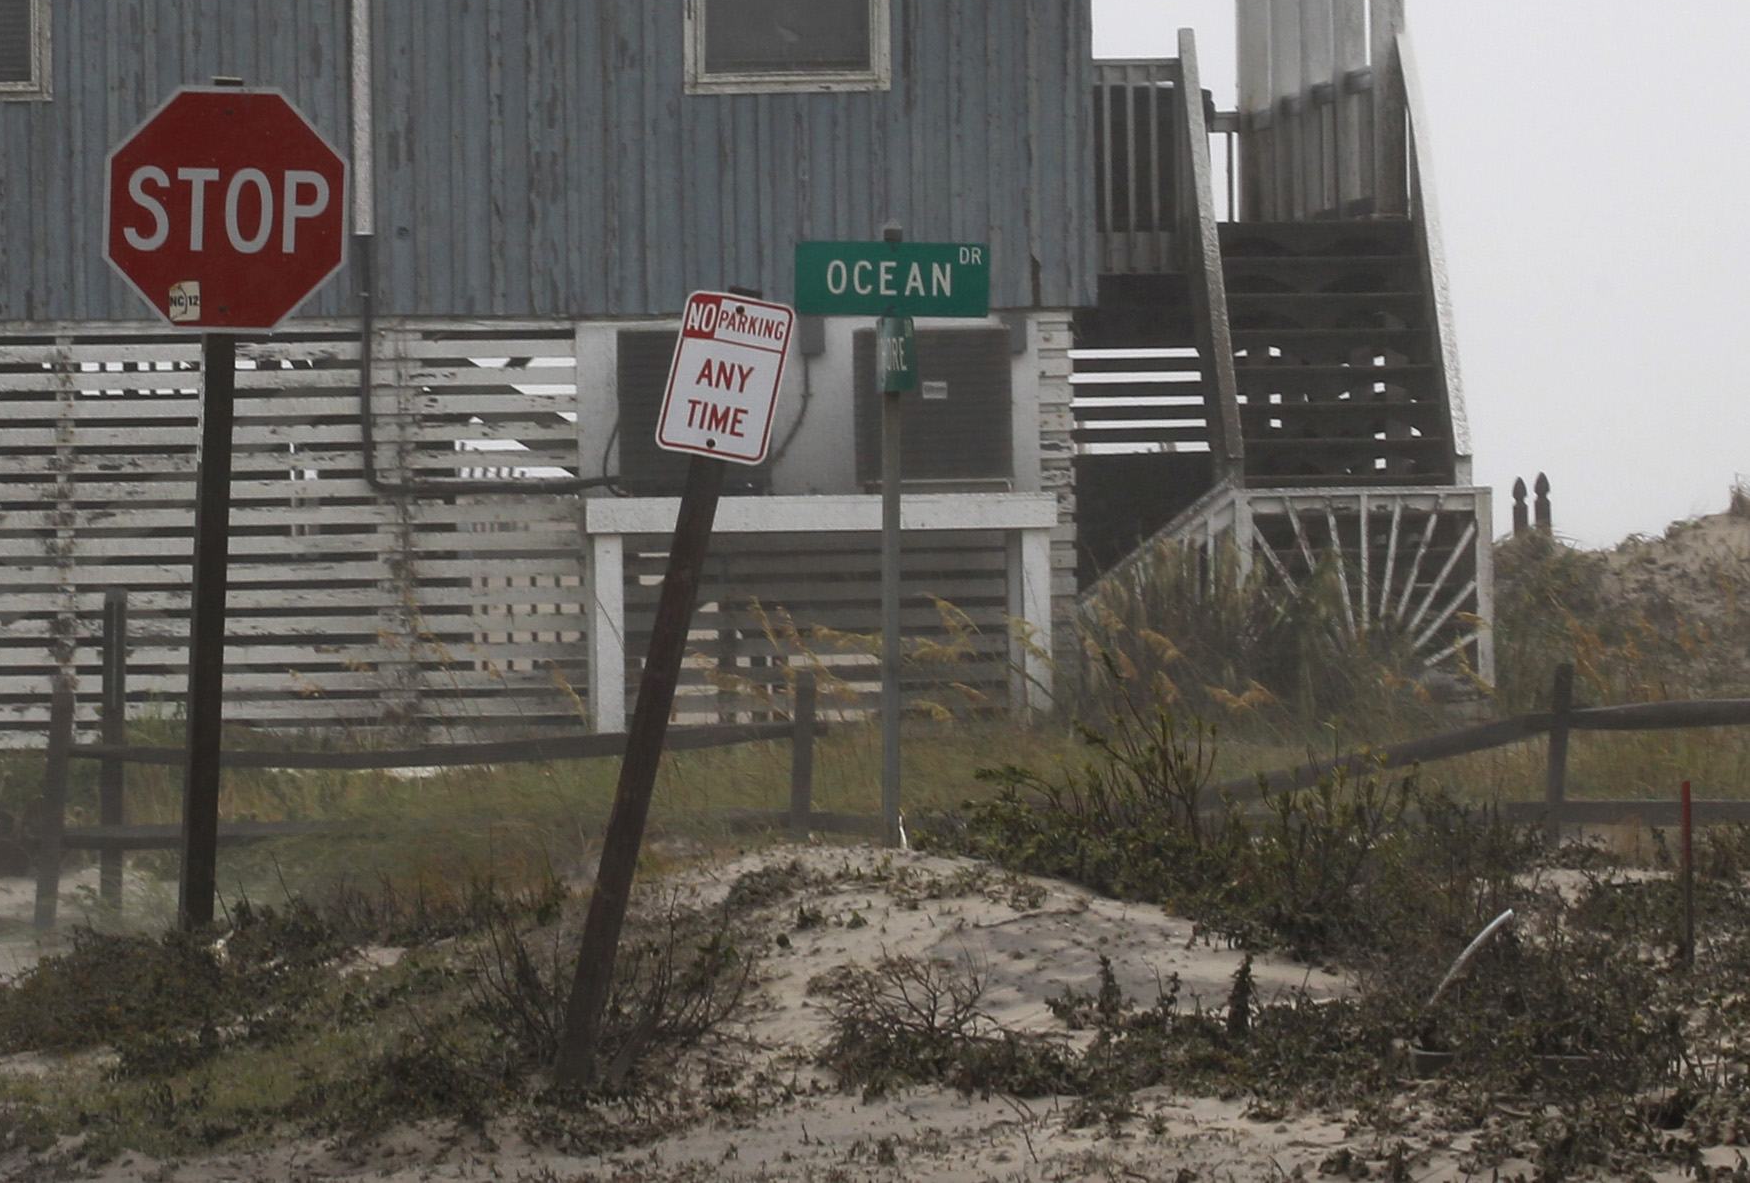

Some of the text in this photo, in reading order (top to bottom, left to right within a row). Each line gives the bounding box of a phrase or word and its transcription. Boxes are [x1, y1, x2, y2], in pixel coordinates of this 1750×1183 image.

[123, 165, 330, 254] STOP
[826, 246, 982, 298] OCEAN DR
[686, 300, 786, 342] NO PARKING
[696, 357, 755, 394] ANY
[686, 398, 749, 439] TIME
